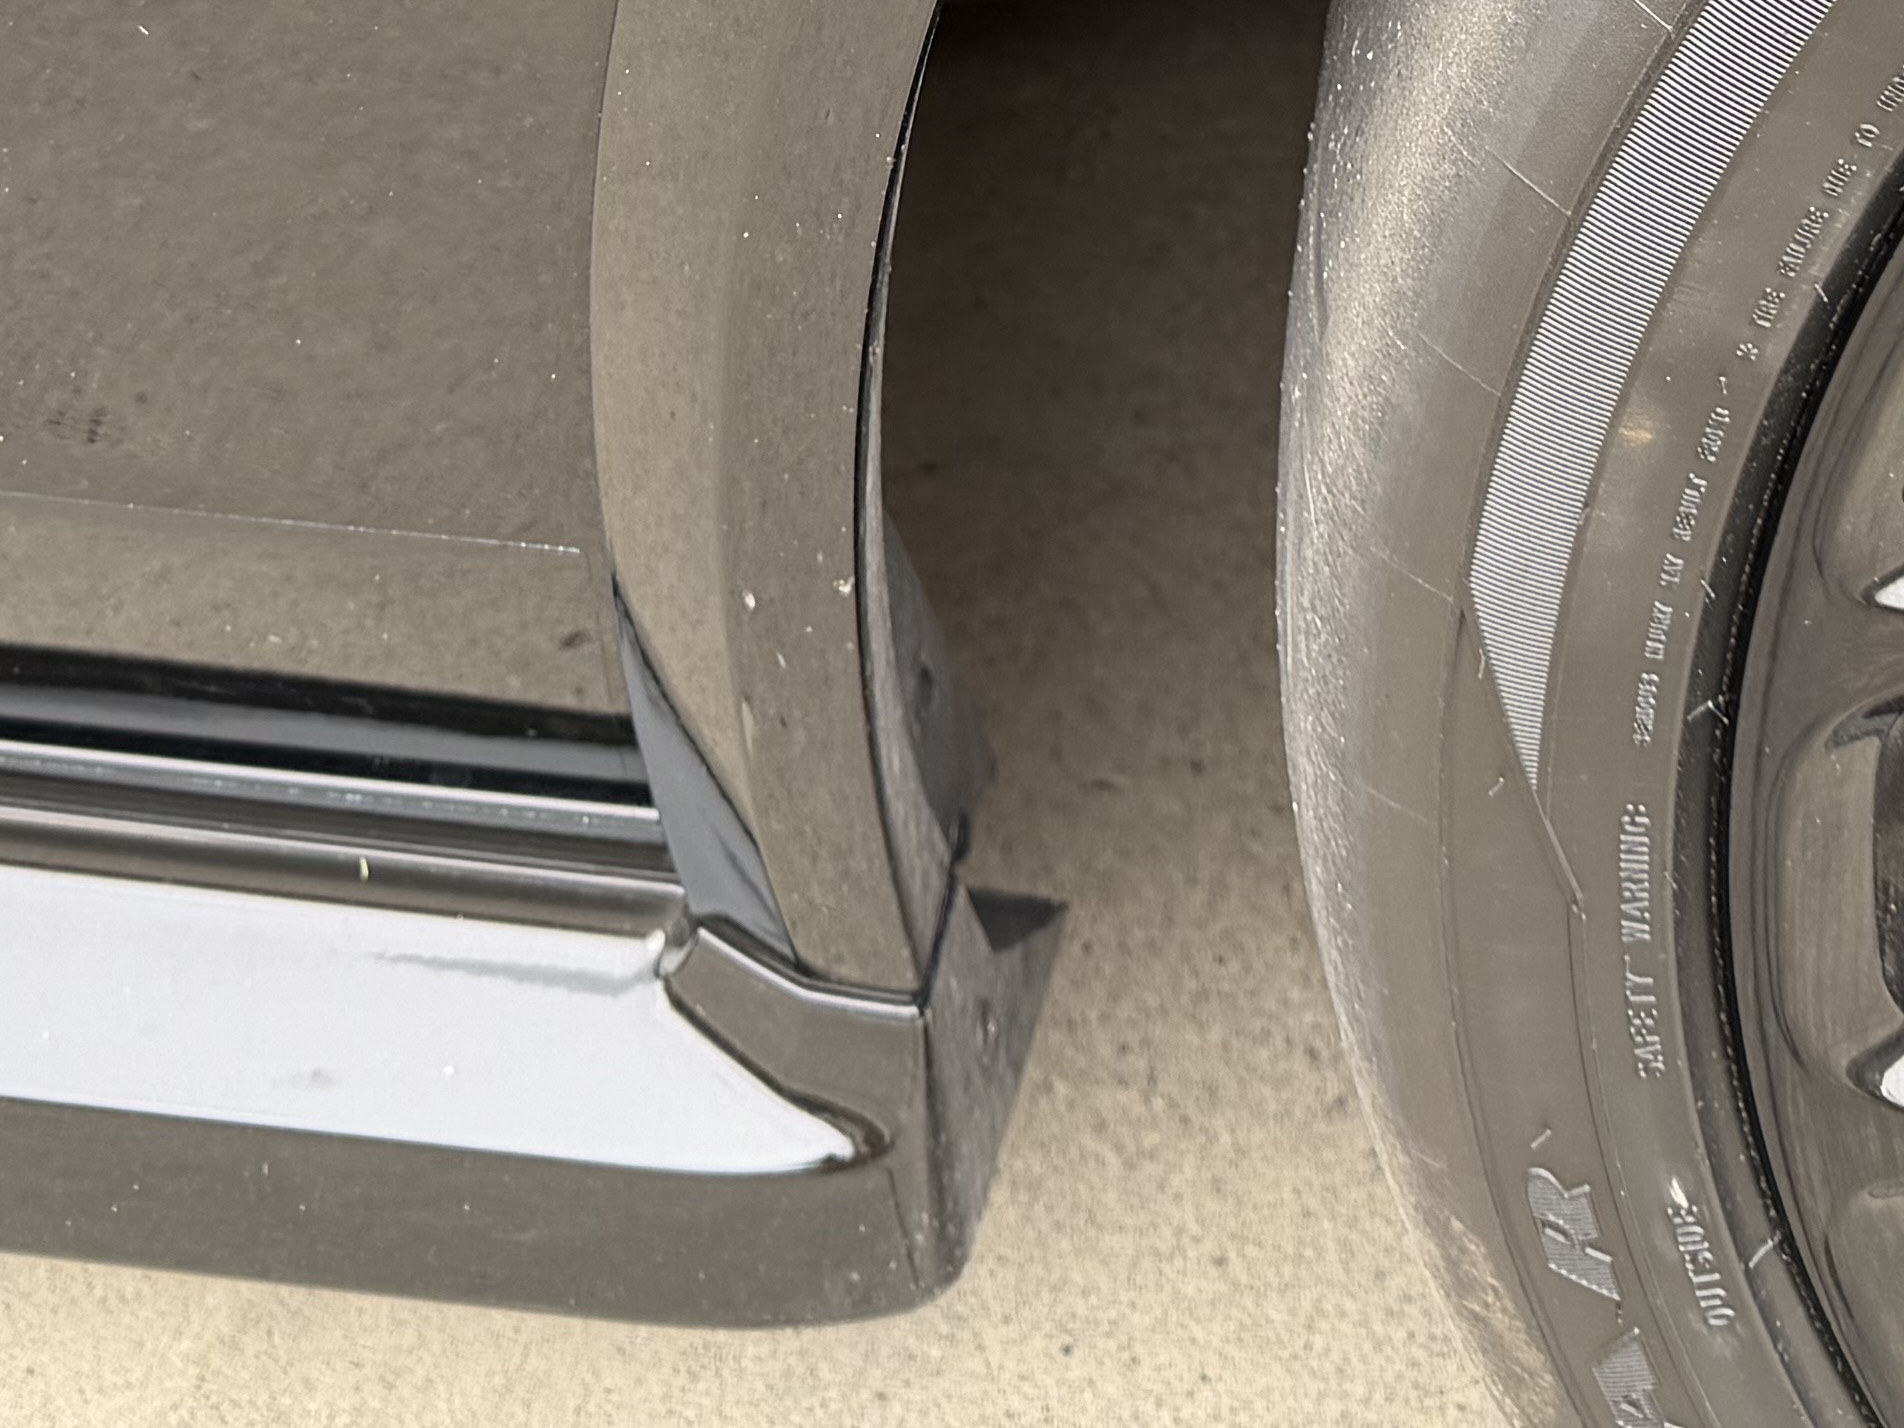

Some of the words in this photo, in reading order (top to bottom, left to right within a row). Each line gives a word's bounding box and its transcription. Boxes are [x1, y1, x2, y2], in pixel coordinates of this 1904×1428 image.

[1617, 803, 1653, 942] WARNING:
[1622, 966, 1666, 1078] SAFETY
[1666, 1204, 1735, 1326] OUTSIDE
